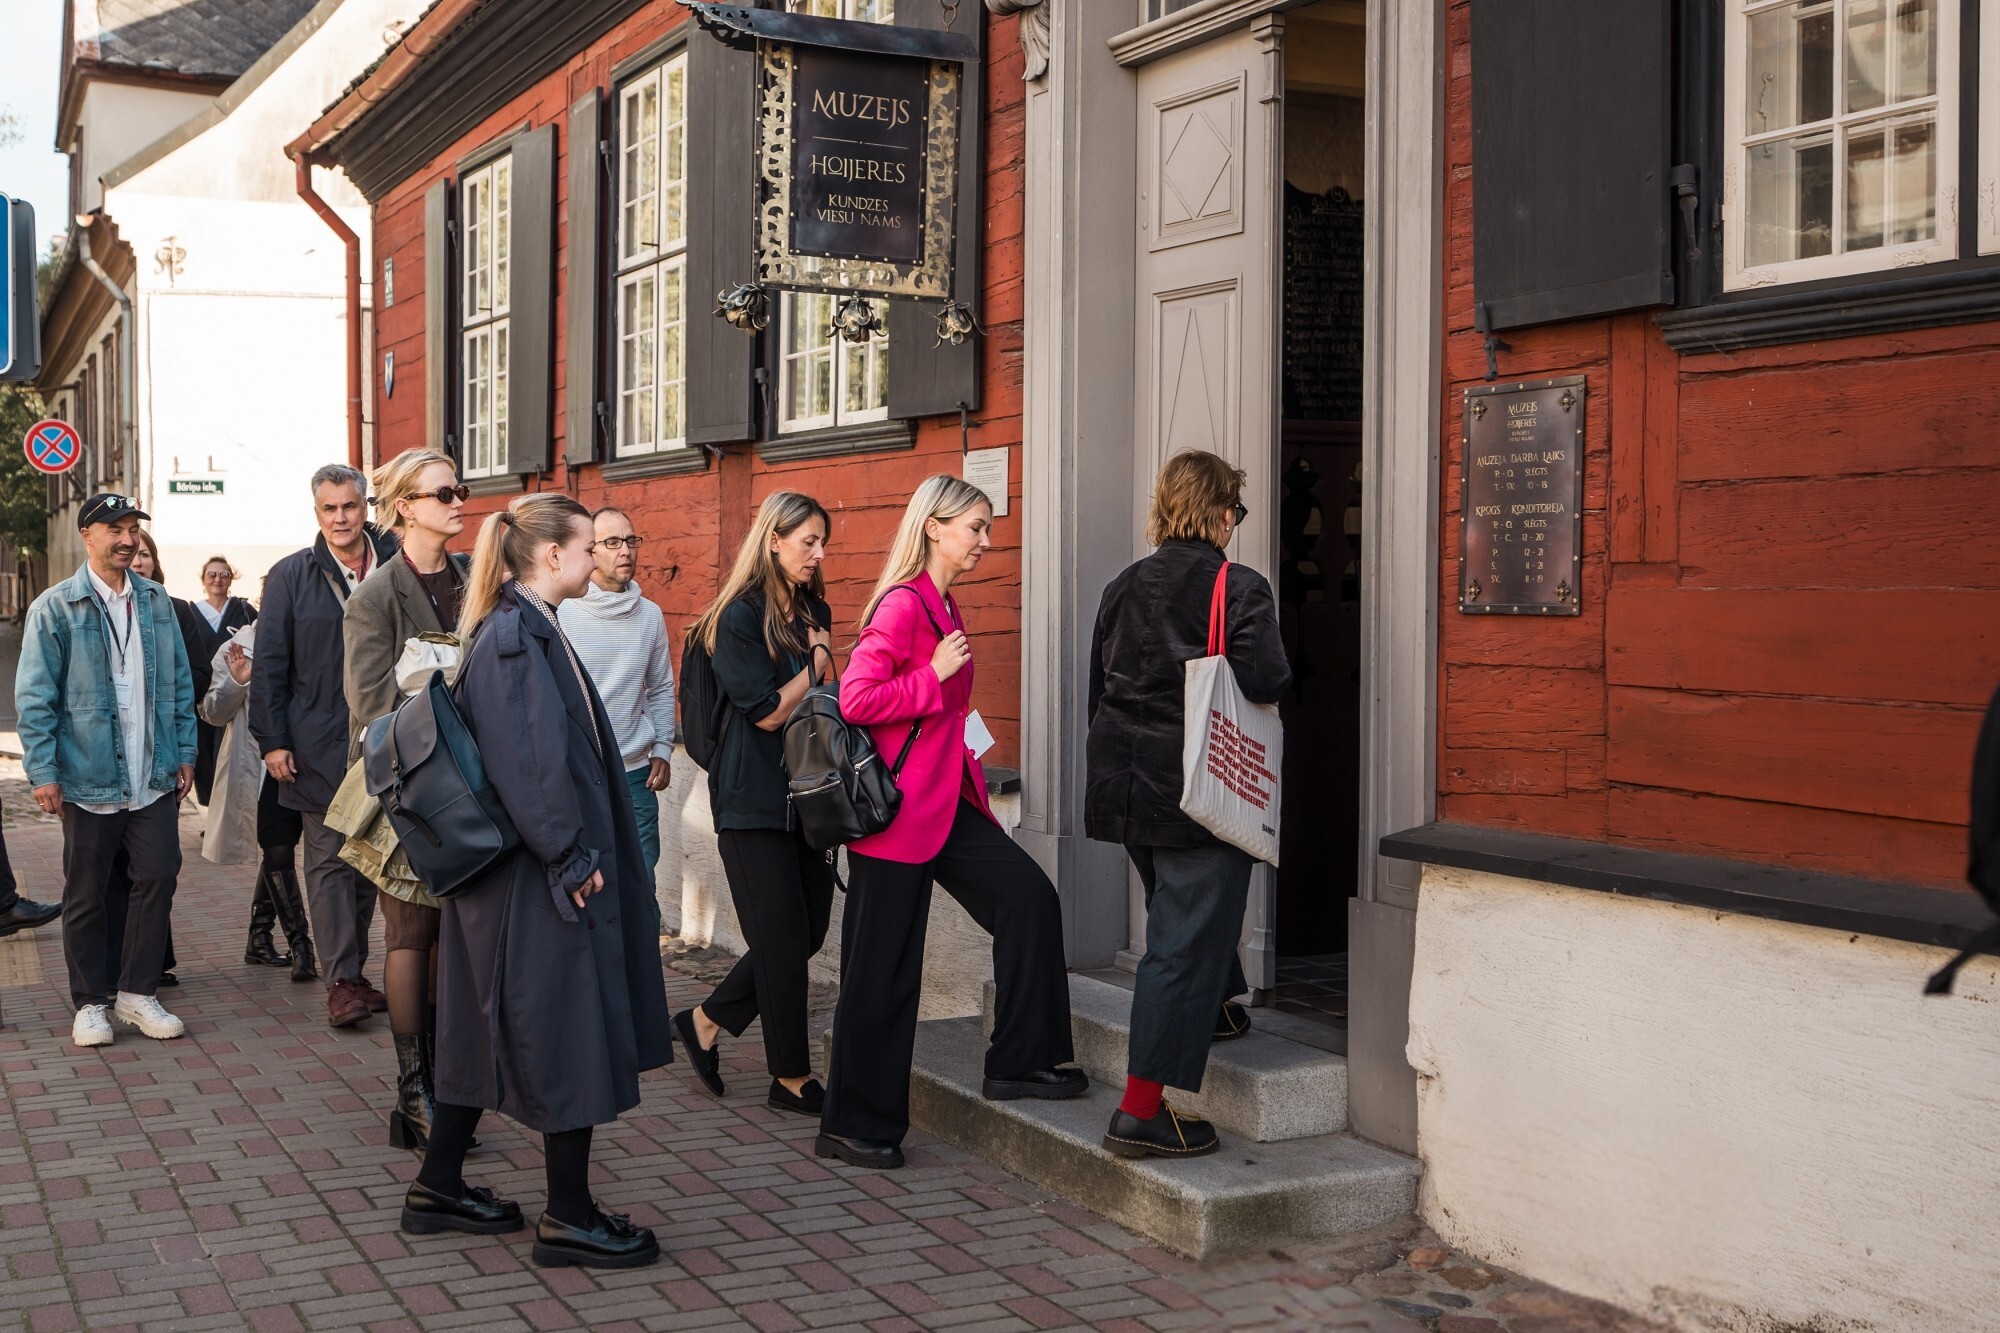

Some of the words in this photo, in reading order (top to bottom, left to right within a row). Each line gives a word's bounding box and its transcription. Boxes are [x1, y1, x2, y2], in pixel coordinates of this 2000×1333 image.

[811, 88, 910, 130] MUZEJS
[808, 154, 906, 184] HOIJERES
[828, 193, 889, 213] KUNDZES
[816, 208, 855, 225] VIESU
[860, 213, 901, 229] NAMS
[1507, 401, 1538, 415] MUZEJS
[1477, 454, 1507, 467] MUZEJA
[1511, 453, 1539, 463] DARBA
[1543, 450, 1565, 464] LAIKS
[202, 481, 216, 492] iela
[1475, 505, 1501, 516] KROGS
[1511, 502, 1565, 515] KONDITOREJA
[1535, 533, 1545, 541] 20
[1524, 548, 1530, 556] 12
[1211, 721, 1219, 731] TO
[1247, 748, 1264, 764] WORLD
[1241, 734, 1265, 754] ANYTHING
[1250, 773, 1258, 785] WE
[1243, 781, 1269, 802] SHOPPING
